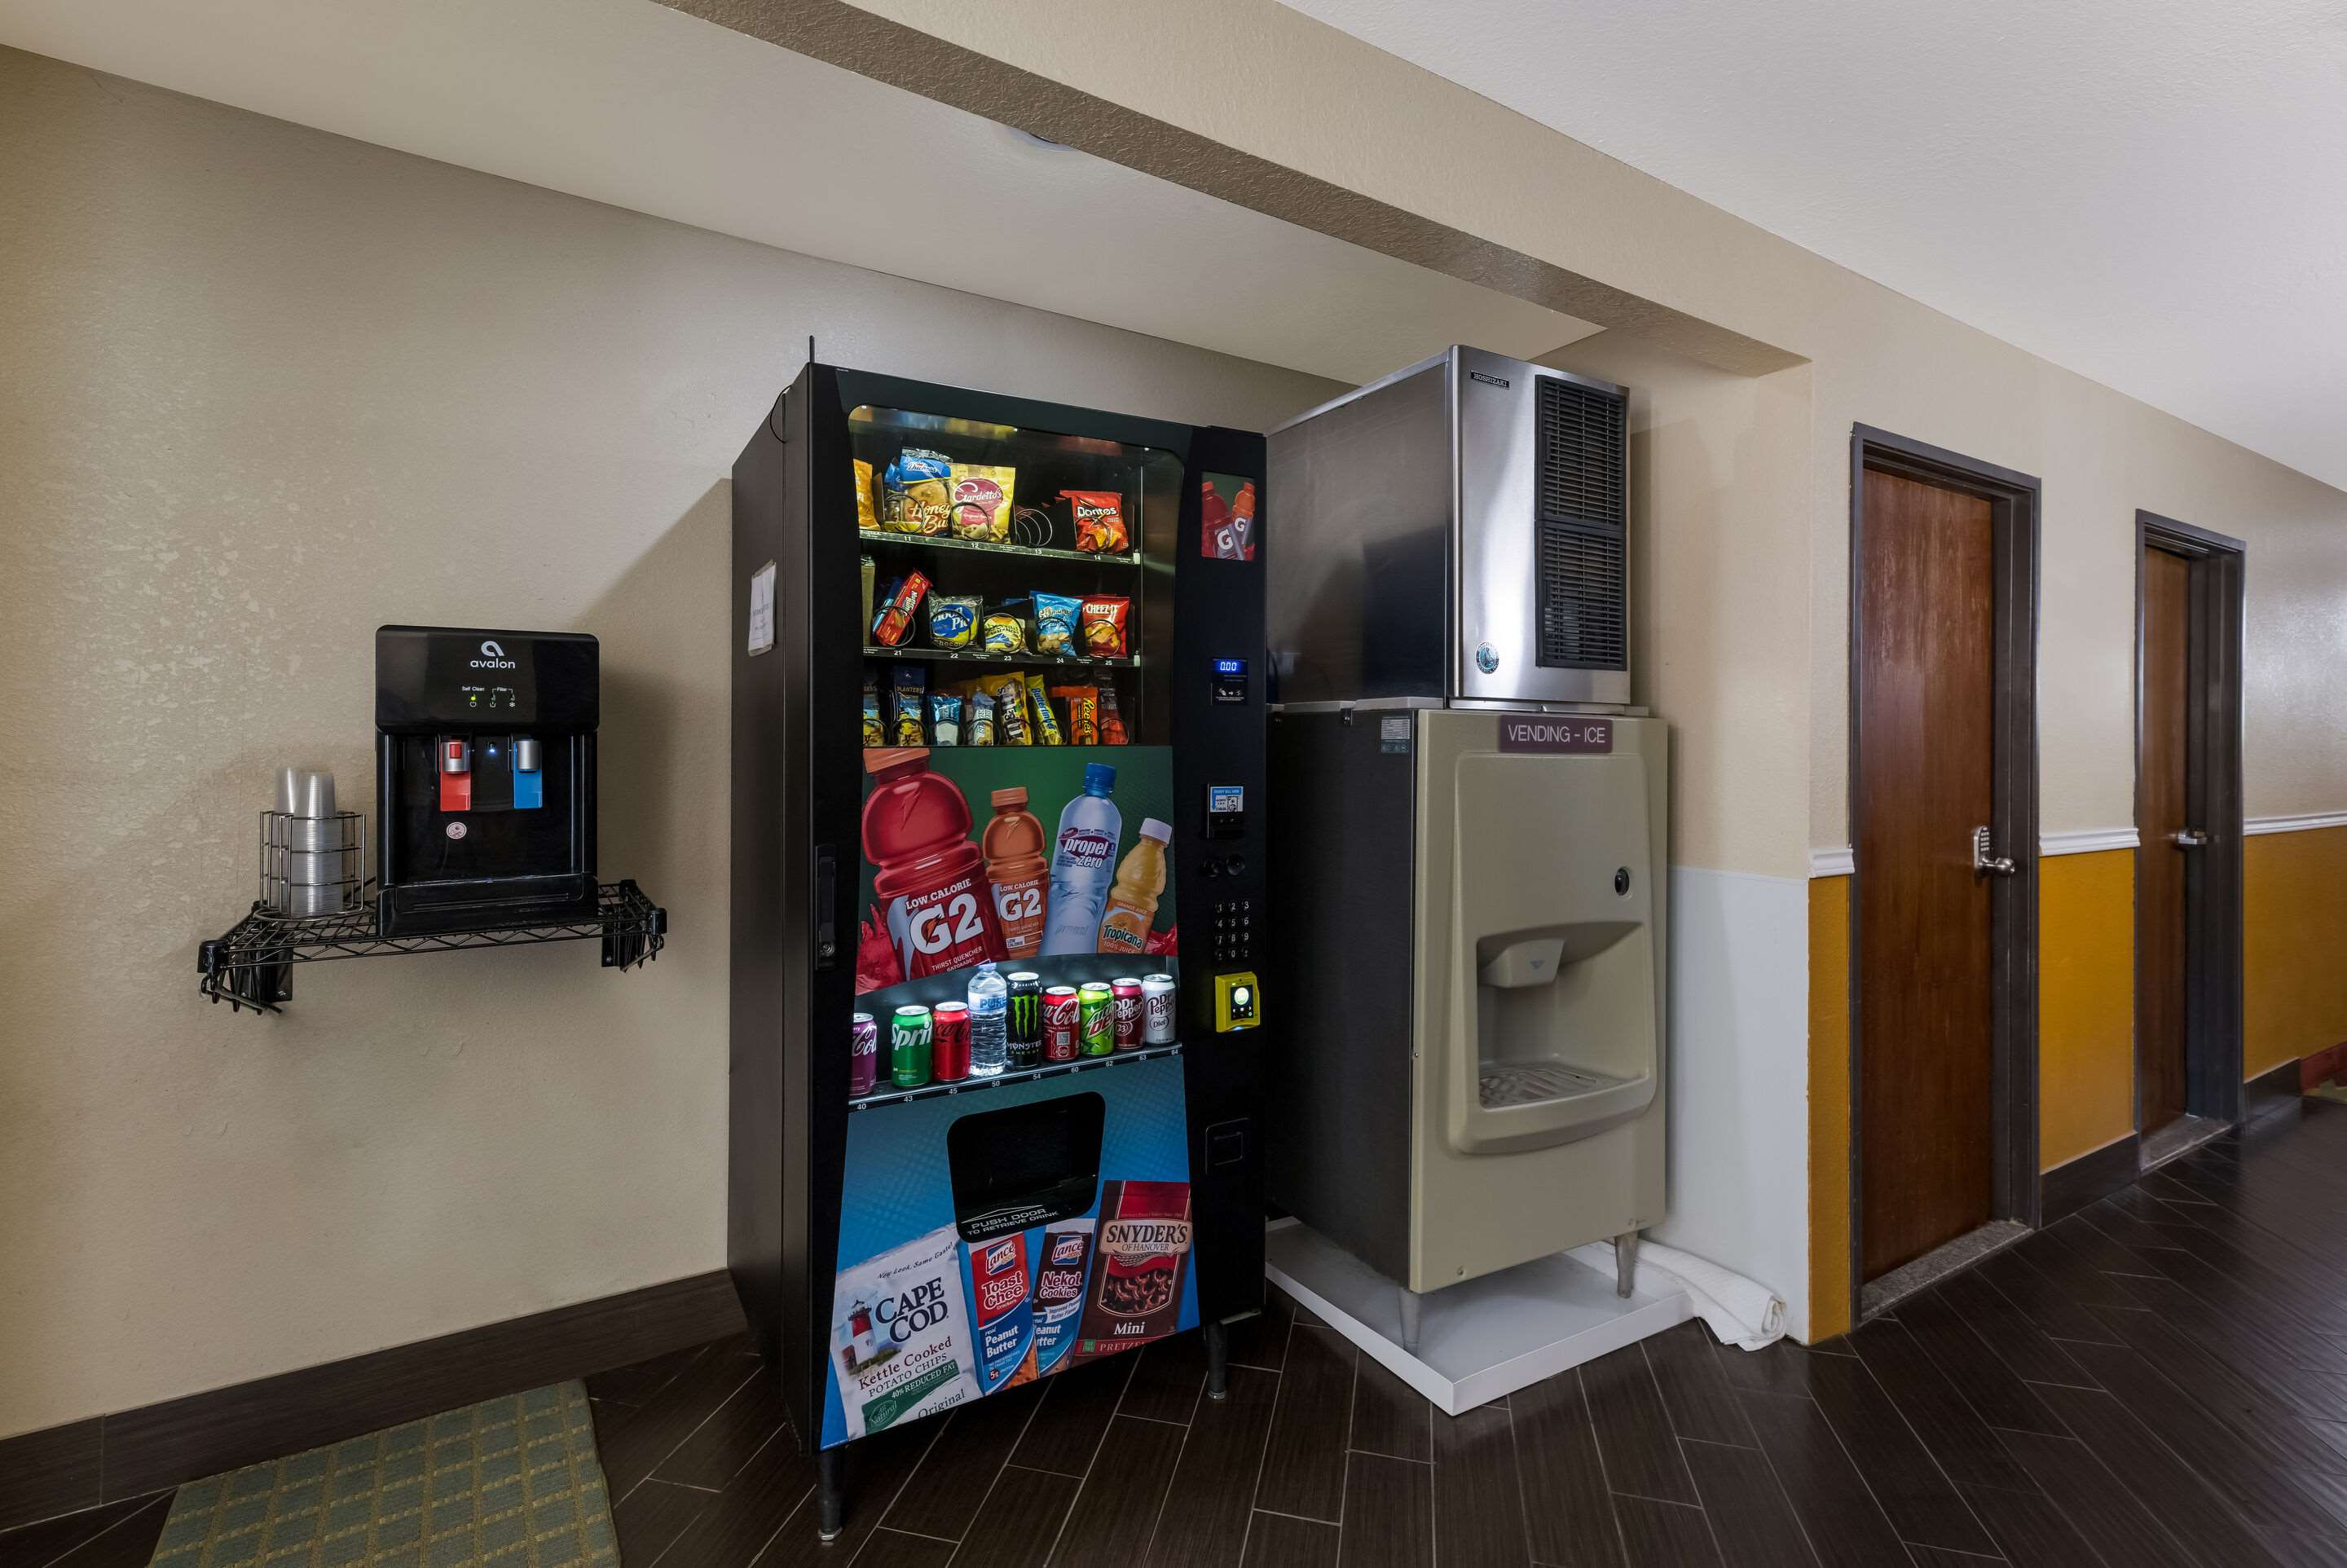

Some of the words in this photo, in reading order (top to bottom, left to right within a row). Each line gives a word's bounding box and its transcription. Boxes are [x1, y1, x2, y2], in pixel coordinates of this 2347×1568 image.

[909, 500, 952, 519] Honey
[1077, 506, 1119, 518] Doritos
[1235, 517, 1246, 532] G
[1217, 528, 1234, 550] G
[470, 658, 516, 669] avalon
[1508, 724, 1570, 742] VENDING
[1584, 727, 1605, 742] ICE
[1063, 839, 1109, 856] propel
[1076, 856, 1103, 868] zero
[905, 895, 928, 910] LOW
[930, 879, 971, 901] CALORIE
[1000, 884, 1014, 892] LOW
[1014, 879, 1039, 890] CALORIE
[1000, 888, 1042, 922] G2
[1117, 902, 1135, 911] ORANGE
[1231, 902, 1236, 910] 2
[1244, 901, 1249, 910] 3
[910, 893, 984, 954] G2
[1218, 919, 1222, 928] 4
[1231, 918, 1236, 927] 5
[1244, 917, 1249, 925] 6
[1103, 925, 1143, 949] Tropicana
[1231, 934, 1236, 942] 8
[1244, 932, 1249, 940] 9
[1103, 940, 1119, 949] 100%
[1119, 945, 1135, 954] JUICE
[932, 960, 952, 971] THIRST
[953, 946, 982, 964] QUENCHER
[1123, 998, 1135, 1011] Dr
[1147, 997, 1174, 1015] Pepper
[1159, 993, 1172, 1006] Dr
[1153, 1020, 1165, 1028] Diet
[971, 1217, 1007, 1230] PUSH
[1011, 1209, 1046, 1220] DOOR
[983, 1219, 1027, 1232] RETRIEVE
[1029, 1211, 1059, 1222] DRINK
[1107, 1223, 1187, 1244] SNYDER'S
[1052, 1240, 1084, 1261] Lance
[1122, 1243, 1134, 1251] OF
[1134, 1243, 1169, 1251] HANOVER
[987, 1243, 1015, 1273] Lance
[878, 1271, 892, 1279] New
[893, 1265, 913, 1274] Look,
[913, 1257, 932, 1268] Same
[981, 1271, 1023, 1296] Toast
[1041, 1271, 1081, 1288] Nekot
[875, 1277, 945, 1324] CAPE
[984, 1284, 1024, 1310] Chee
[1040, 1287, 1077, 1299] Cookies
[890, 1301, 948, 1343] COD
[984, 1326, 996, 1336] real
[1034, 1324, 1061, 1335] eanut
[1113, 1321, 1146, 1335] Mini
[985, 1325, 1019, 1346] Peanut
[987, 1338, 1018, 1359] Butter
[858, 1363, 900, 1390] Kettle
[904, 1336, 952, 1367] Cooked
[869, 1370, 912, 1397] POTATO
[915, 1353, 947, 1374] CHIPS
[892, 1389, 905, 1398] 40%
[905, 1370, 942, 1394] REDUCED
[943, 1363, 956, 1374] FAT
[918, 1389, 965, 1419] Original
